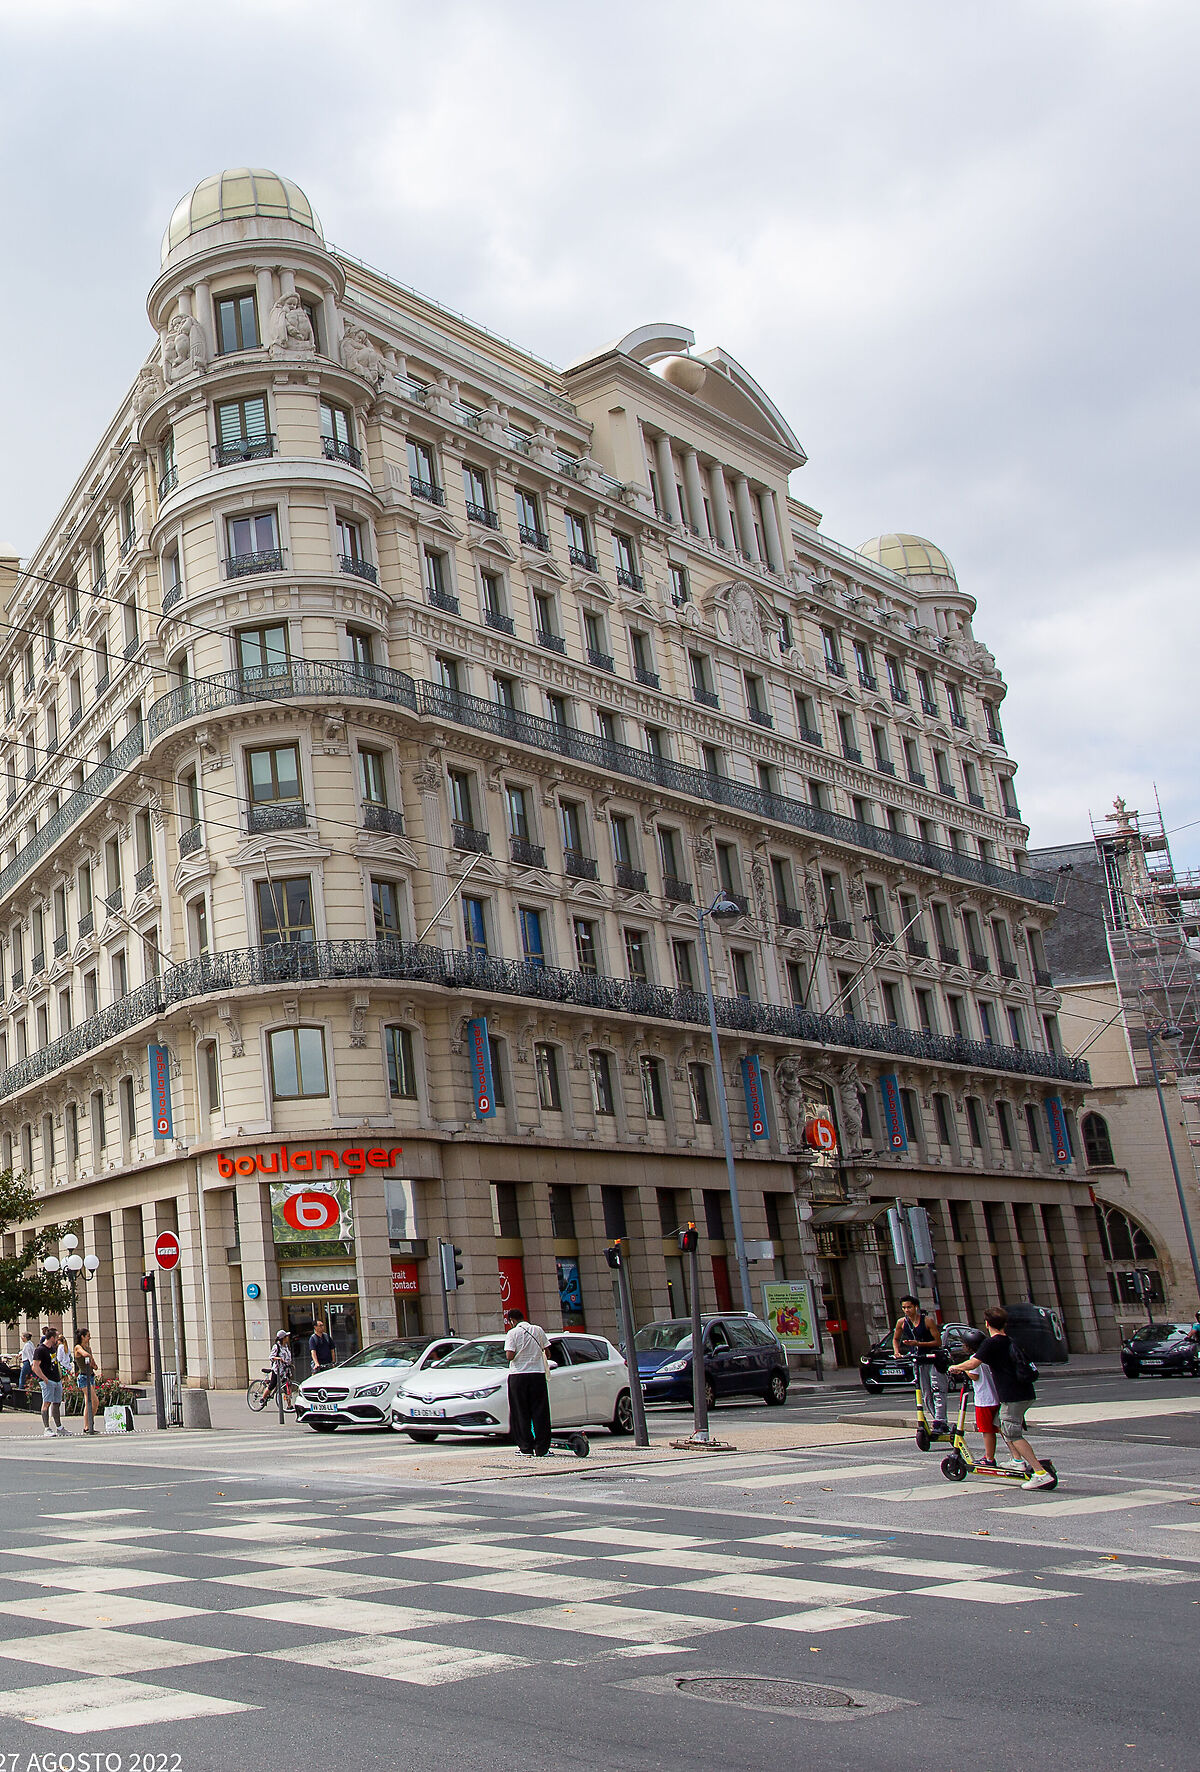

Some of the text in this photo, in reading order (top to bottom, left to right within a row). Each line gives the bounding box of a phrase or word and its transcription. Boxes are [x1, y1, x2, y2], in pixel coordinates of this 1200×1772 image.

[155, 1050, 166, 1116] boulanger
[473, 1024, 487, 1093] boulanger
[746, 1060, 761, 1119] boulanger
[885, 1079, 900, 1133] boulanger
[1050, 1100, 1065, 1148] boulanger
[217, 1146, 403, 1178] boulanger
[291, 1282, 350, 1292] Bienvenue
